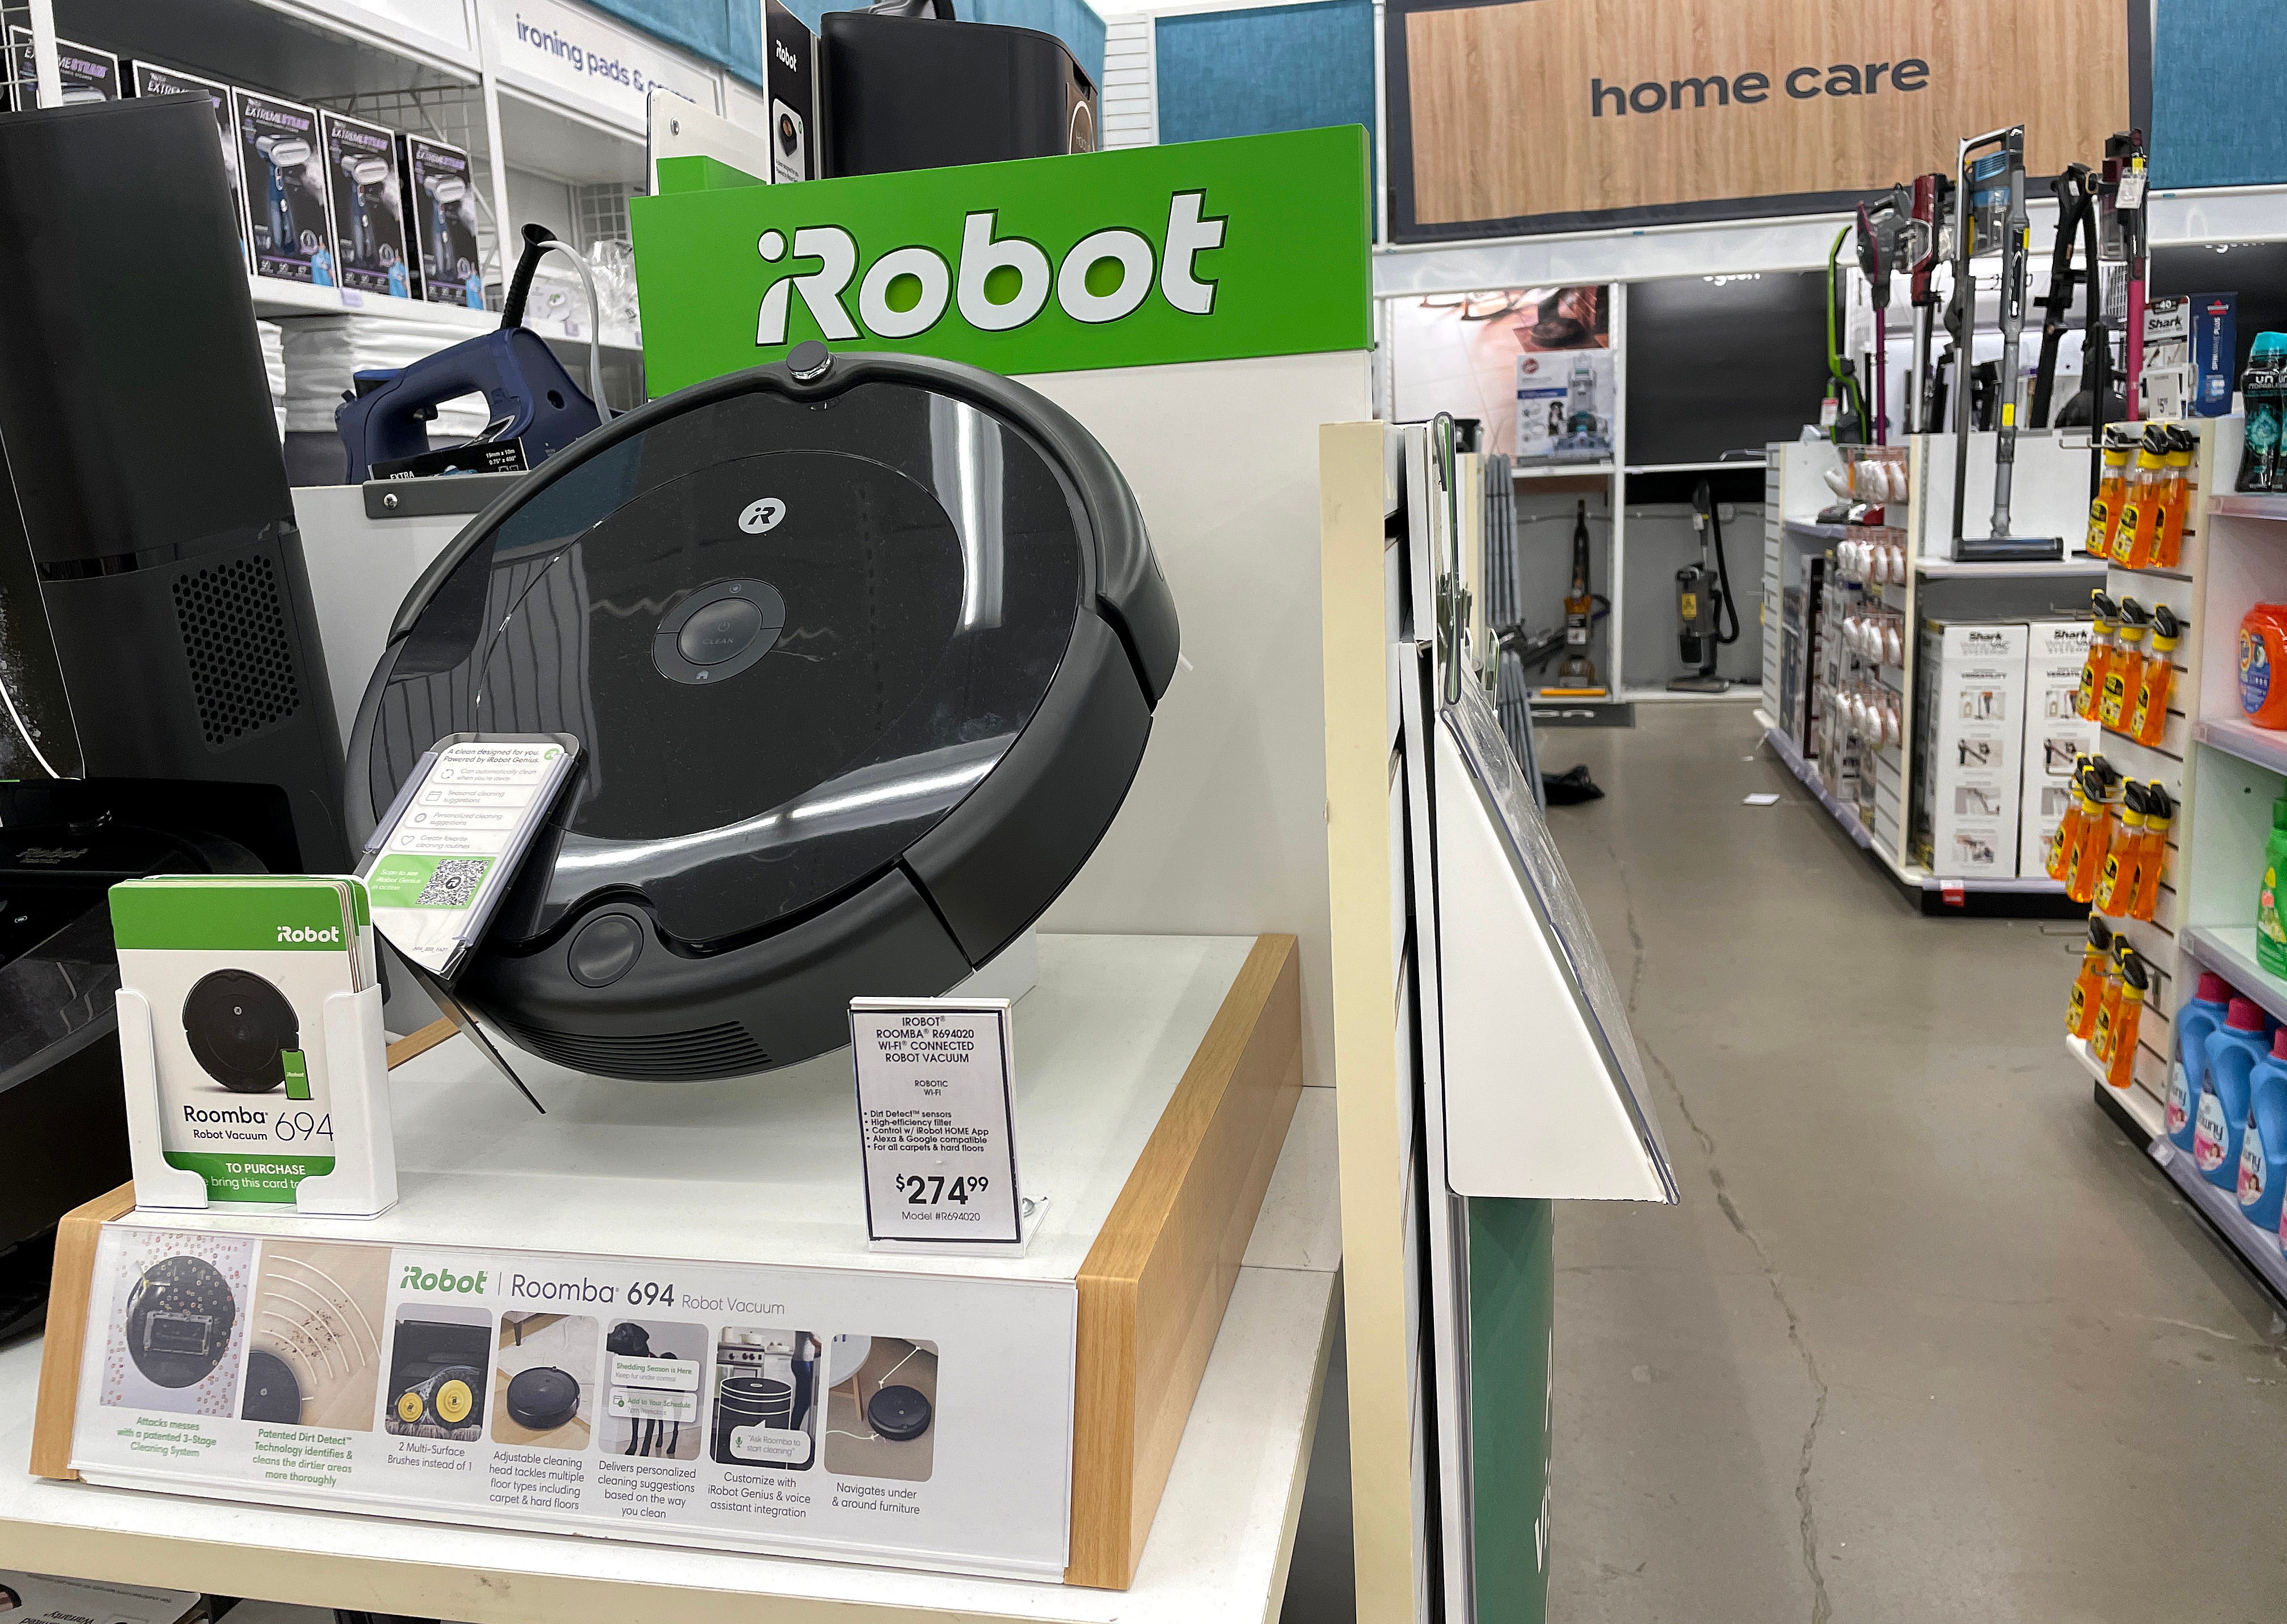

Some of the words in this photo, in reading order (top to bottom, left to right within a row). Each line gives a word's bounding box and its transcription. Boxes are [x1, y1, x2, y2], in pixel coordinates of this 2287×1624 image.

[517, 14, 583, 71] ironing
[587, 50, 629, 87] pads
[632, 70, 645, 90] &
[1592, 71, 1770, 117] home
[1786, 58, 1929, 99] care
[754, 188, 1229, 347] iRobot
[2149, 315, 2182, 329] Shark
[390, 471, 414, 480] EXTRA
[1969, 631, 2002, 640] Shark
[2054, 629, 2087, 638] Shark
[277, 926, 339, 942] iRobot
[932, 1030, 974, 1038] R694020
[911, 1042, 974, 1050] CONNECTED
[885, 1054, 919, 1062] ROBOT
[922, 1054, 969, 1062] VACUUM
[184, 1105, 265, 1124] Roomba
[276, 1112, 333, 1141] 694
[193, 1130, 223, 1139] Robot
[225, 1130, 267, 1140] Vacuum
[226, 1163, 242, 1173] TO
[244, 1164, 306, 1175] PURCHASE
[211, 1177, 239, 1189] bring
[242, 1178, 260, 1188] this
[263, 1179, 287, 1189] card
[400, 1266, 487, 1294] iRobot
[512, 1274, 614, 1303] Roomba
[627, 1282, 674, 1307] 694
[682, 1295, 724, 1310] Robot
[727, 1297, 784, 1314] Vacuum
[617, 1363, 645, 1372] Shedding
[136, 1417, 168, 1427] Attacks
[170, 1422, 200, 1431] messes
[117, 1428, 134, 1436] with
[143, 1432, 181, 1441] patented
[183, 1434, 217, 1447] 3-Stage
[259, 1429, 297, 1440] Patented
[298, 1432, 315, 1442] Dirt
[763, 1436, 792, 1445] Roomba
[130, 1441, 168, 1457] Cleaning
[171, 1446, 200, 1458] System
[255, 1441, 303, 1457] Technology
[305, 1446, 344, 1458] identifies
[347, 1450, 353, 1459] &
[399, 1441, 404, 1451] 2
[407, 1443, 465, 1456] Multi-Surface
[252, 1455, 280, 1465] cleans
[282, 1457, 296, 1467] the
[298, 1459, 326, 1470] dirtier
[327, 1464, 352, 1473] areas
[388, 1454, 420, 1466] Brushes
[422, 1457, 454, 1469] instead
[457, 1461, 466, 1470] of
[493, 1451, 541, 1464] Adjustable
[543, 1456, 583, 1470] cleaning
[489, 1464, 512, 1475] head
[515, 1467, 546, 1478] tackles
[548, 1471, 584, 1483] multiple
[599, 1460, 634, 1473] Delivers
[636, 1466, 696, 1478] personalized
[265, 1471, 288, 1479] more
[290, 1472, 337, 1487] thoroughly
[598, 1474, 637, 1490] cleaning
[640, 1480, 695, 1492] suggestions
[724, 1471, 775, 1486] Customize
[778, 1477, 796, 1487] with
[491, 1478, 511, 1488] floor
[514, 1481, 537, 1492] types
[539, 1483, 580, 1498] including
[708, 1485, 739, 1496] iRobot
[741, 1488, 774, 1500] Genius
[777, 1491, 783, 1501] &
[786, 1492, 811, 1503] voice
[837, 1482, 885, 1497] Navigates
[888, 1488, 917, 1499] under
[490, 1494, 519, 1505] carpet
[522, 1495, 528, 1505] &
[531, 1496, 551, 1507] hard
[554, 1498, 579, 1509] floors
[605, 1488, 634, 1501] based
[651, 1494, 665, 1504] the
[668, 1498, 686, 1508] way
[832, 1496, 838, 1507] &
[841, 1500, 876, 1510] around
[880, 1500, 920, 1514] furniture
[622, 1507, 638, 1517] you
[640, 1507, 666, 1519] clean
[710, 1500, 752, 1512] assistant
[754, 1503, 806, 1517] integration
